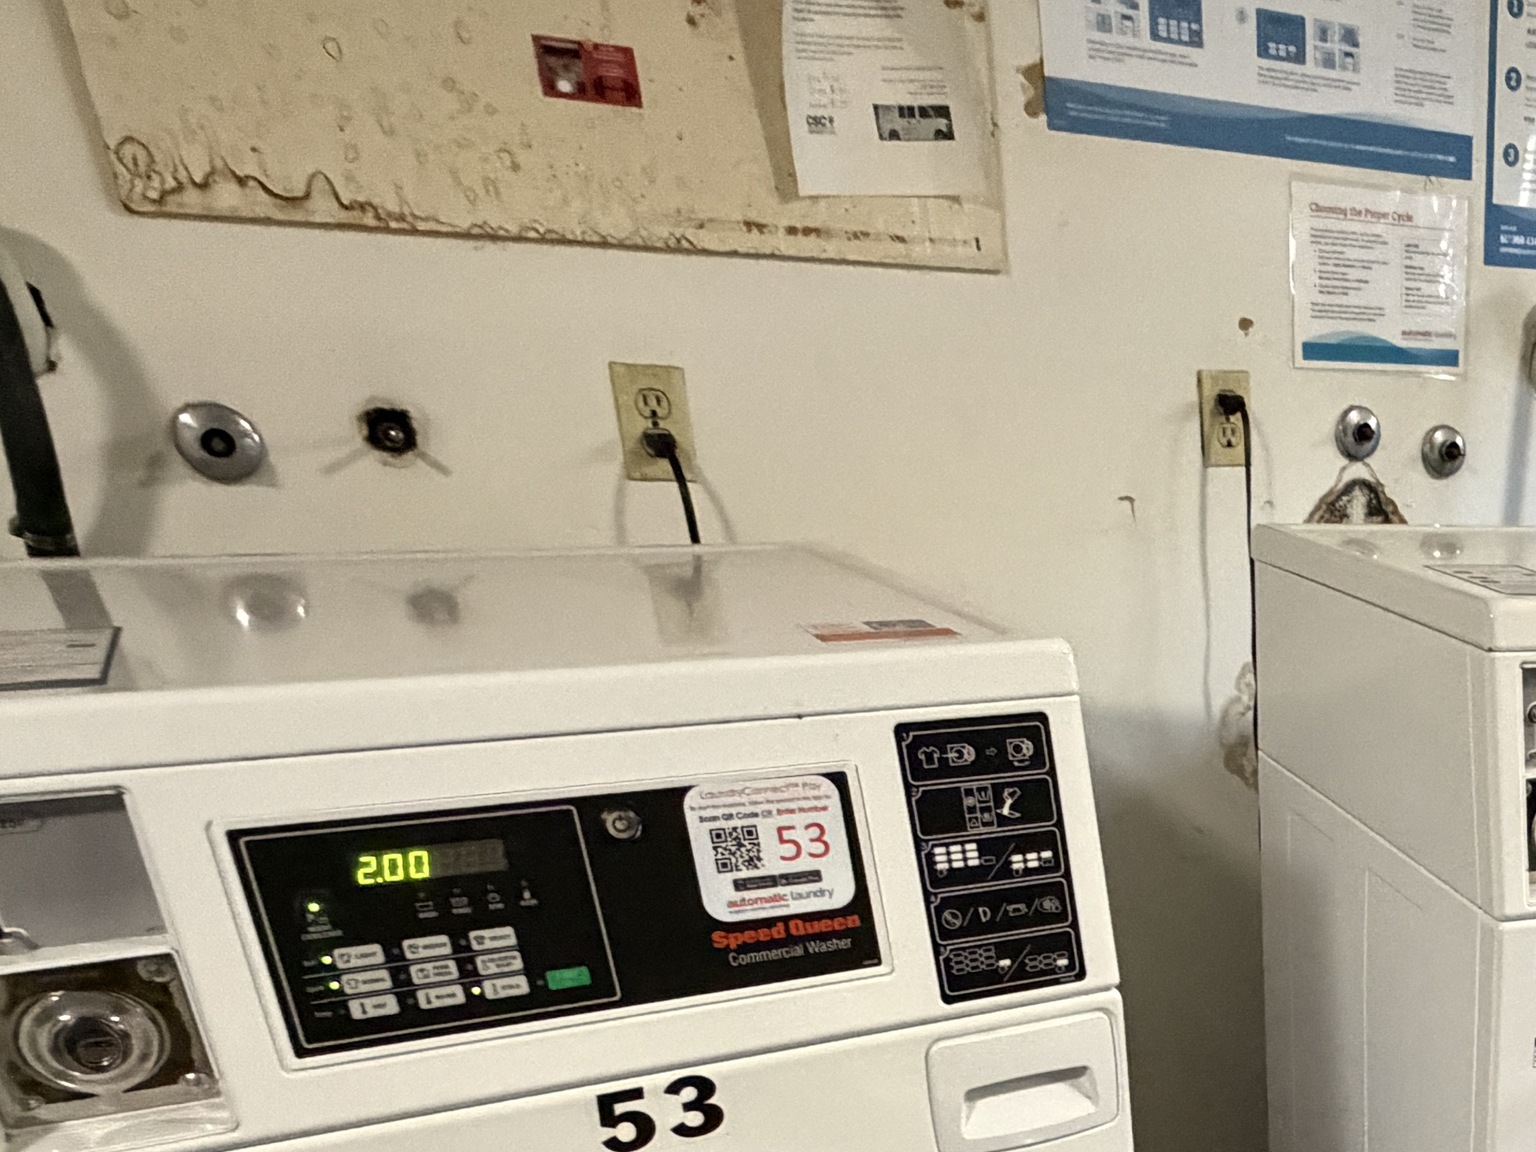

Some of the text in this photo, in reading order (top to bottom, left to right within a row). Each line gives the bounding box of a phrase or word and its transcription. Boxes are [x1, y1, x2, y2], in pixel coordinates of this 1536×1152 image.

[1309, 202, 1414, 223] Choosing the Proper Cycle
[736, 811, 760, 820] Code
[776, 822, 831, 861] 53
[357, 850, 429, 885] 2.00
[727, 888, 834, 909] automatic laundry
[711, 914, 861, 949] Speed Queen
[728, 937, 852, 966] Commercial Washer
[596, 1075, 725, 1152] 53
